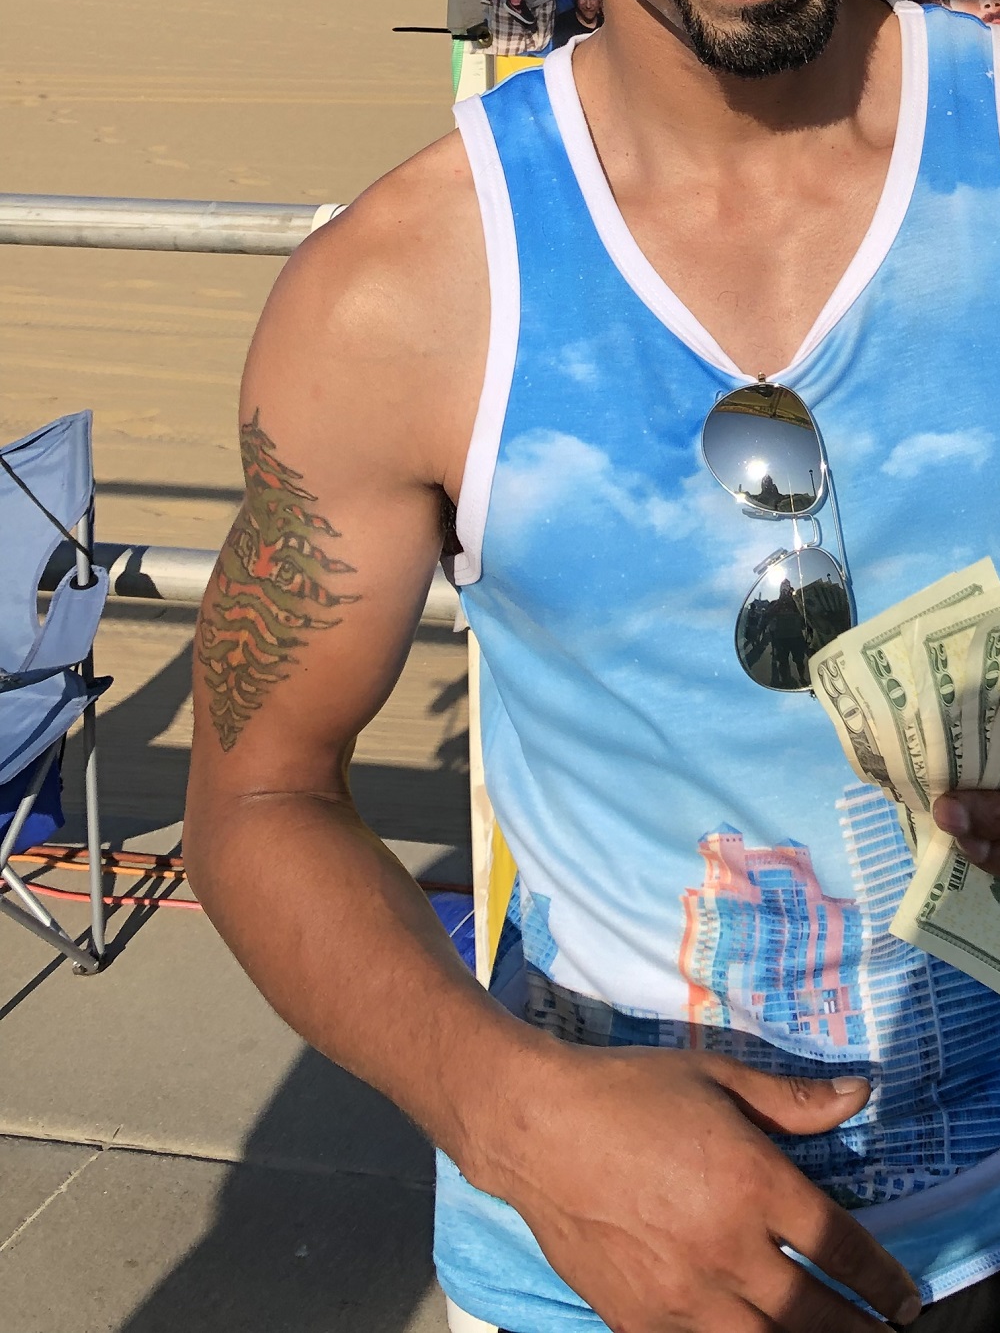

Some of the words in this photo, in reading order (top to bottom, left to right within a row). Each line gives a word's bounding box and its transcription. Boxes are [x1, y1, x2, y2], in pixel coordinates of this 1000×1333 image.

[819, 656, 867, 736] 20
[868, 647, 910, 711] 20
[927, 639, 956, 707] 20
